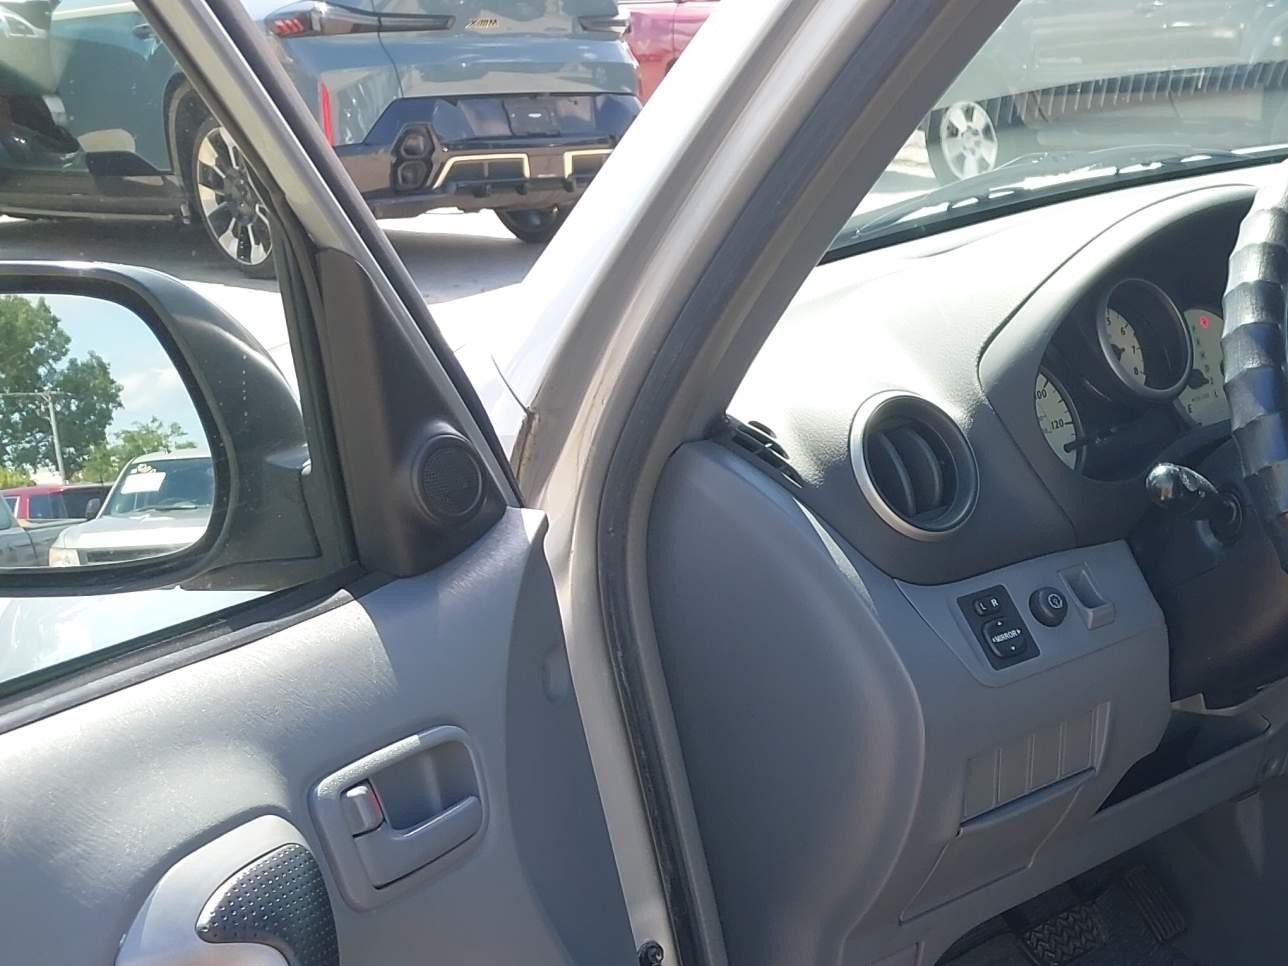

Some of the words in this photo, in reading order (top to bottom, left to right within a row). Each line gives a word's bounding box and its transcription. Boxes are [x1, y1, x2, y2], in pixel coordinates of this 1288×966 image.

[1051, 419, 1065, 430] 120
[979, 602, 987, 610] L
[990, 598, 999, 607] R
[994, 630, 1017, 642] MIRROR
